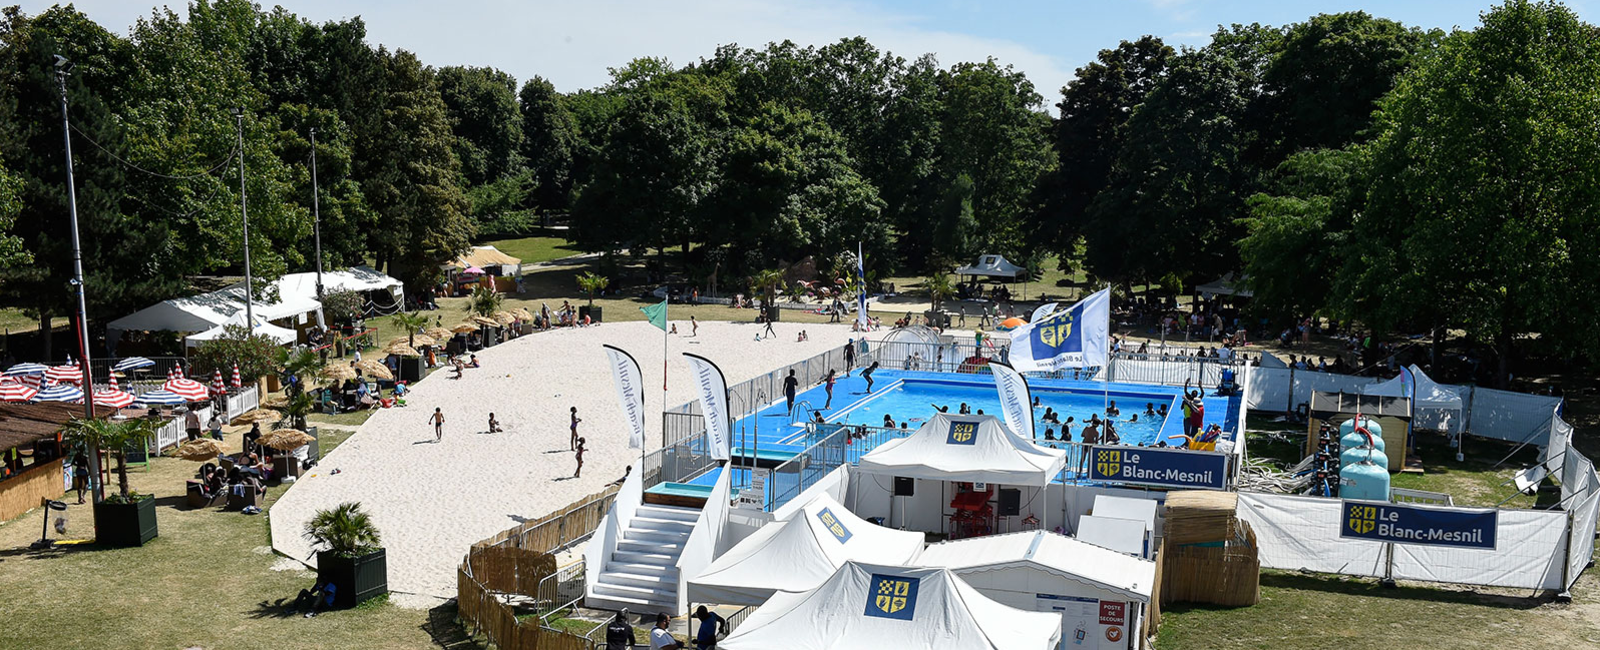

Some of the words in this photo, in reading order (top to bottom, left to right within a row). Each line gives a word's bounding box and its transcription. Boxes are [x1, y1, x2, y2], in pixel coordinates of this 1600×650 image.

[1123, 452, 1140, 464] Le
[1123, 466, 1212, 483] Blanc-Mesnil
[1380, 508, 1399, 521] Le
[1378, 524, 1482, 543] Blanc-Mesnil
